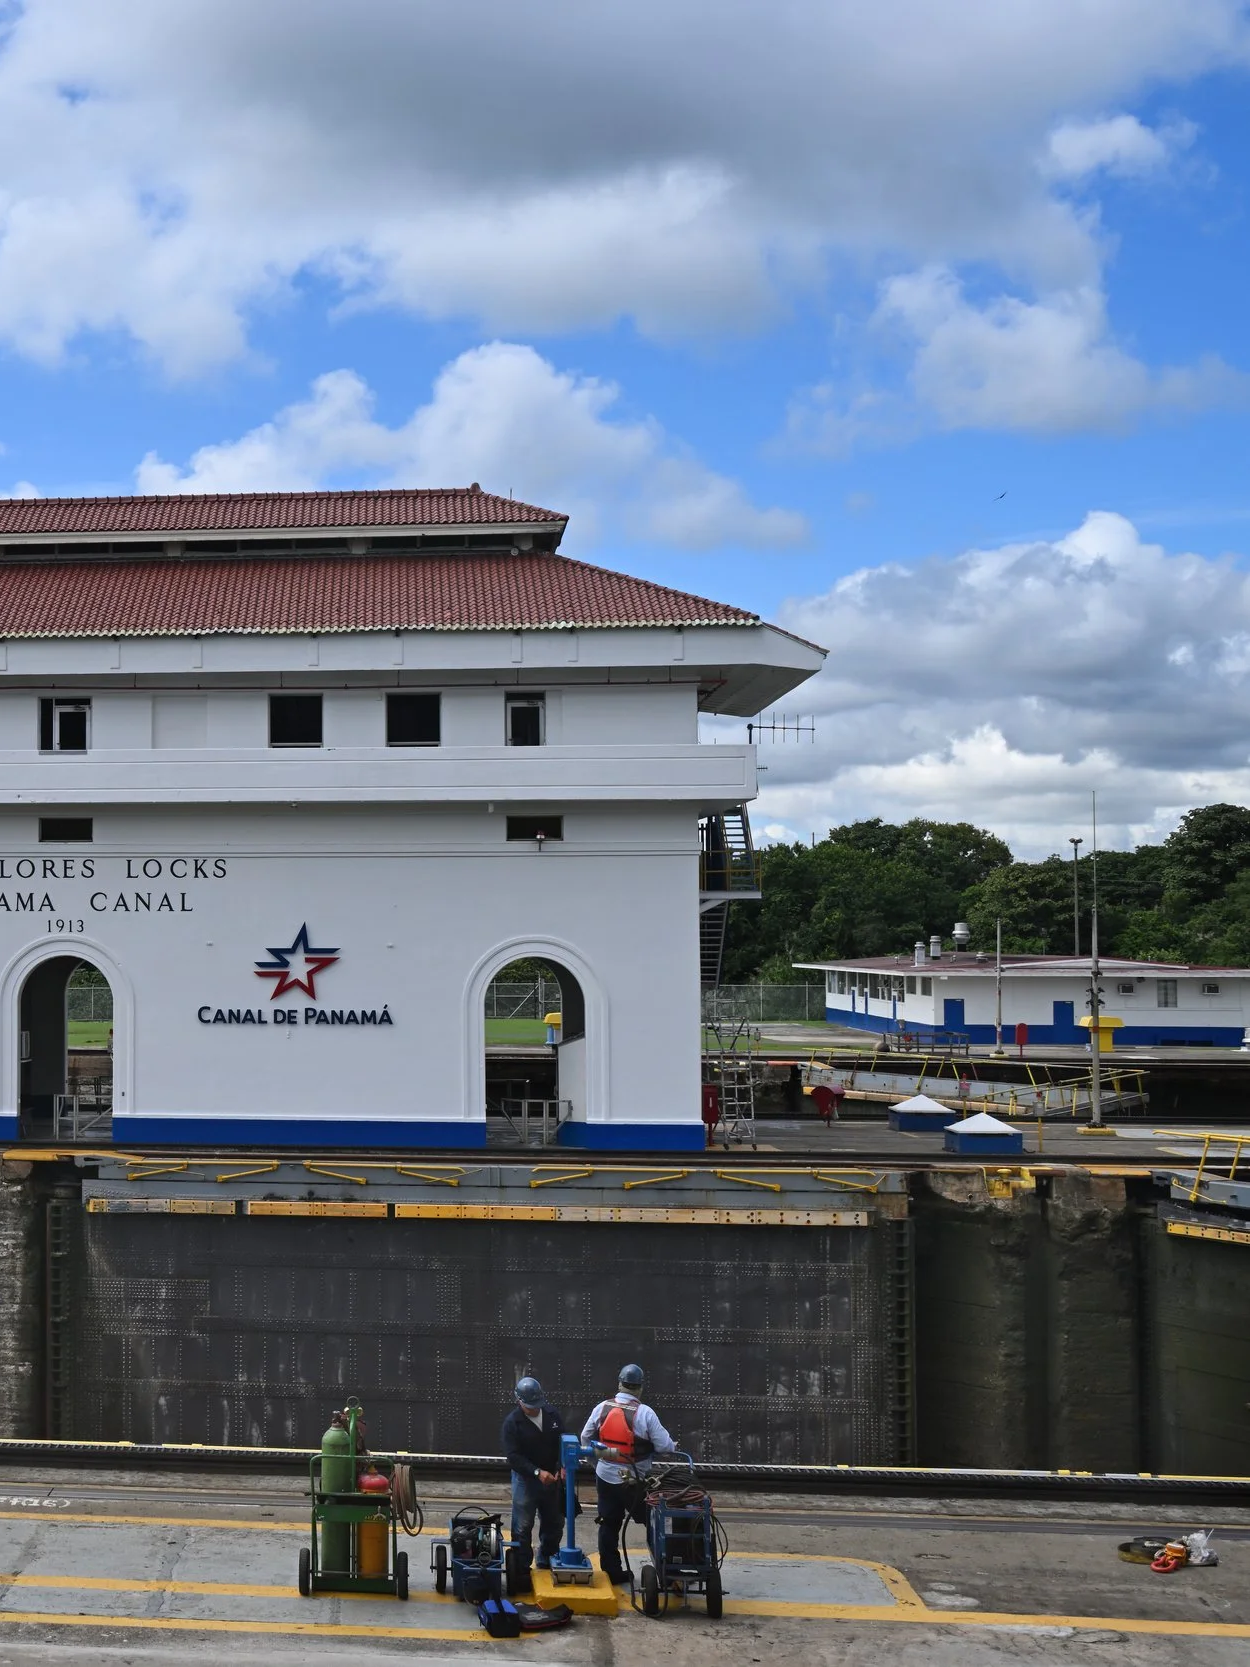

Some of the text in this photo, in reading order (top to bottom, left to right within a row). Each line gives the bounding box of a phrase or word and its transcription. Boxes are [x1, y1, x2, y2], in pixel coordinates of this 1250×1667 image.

[125, 858, 228, 880] LOCKS
[89, 891, 194, 912] CANAL
[46, 918, 85, 934] 1913
[197, 1003, 395, 1026] CANAL DE PANAMÁ
